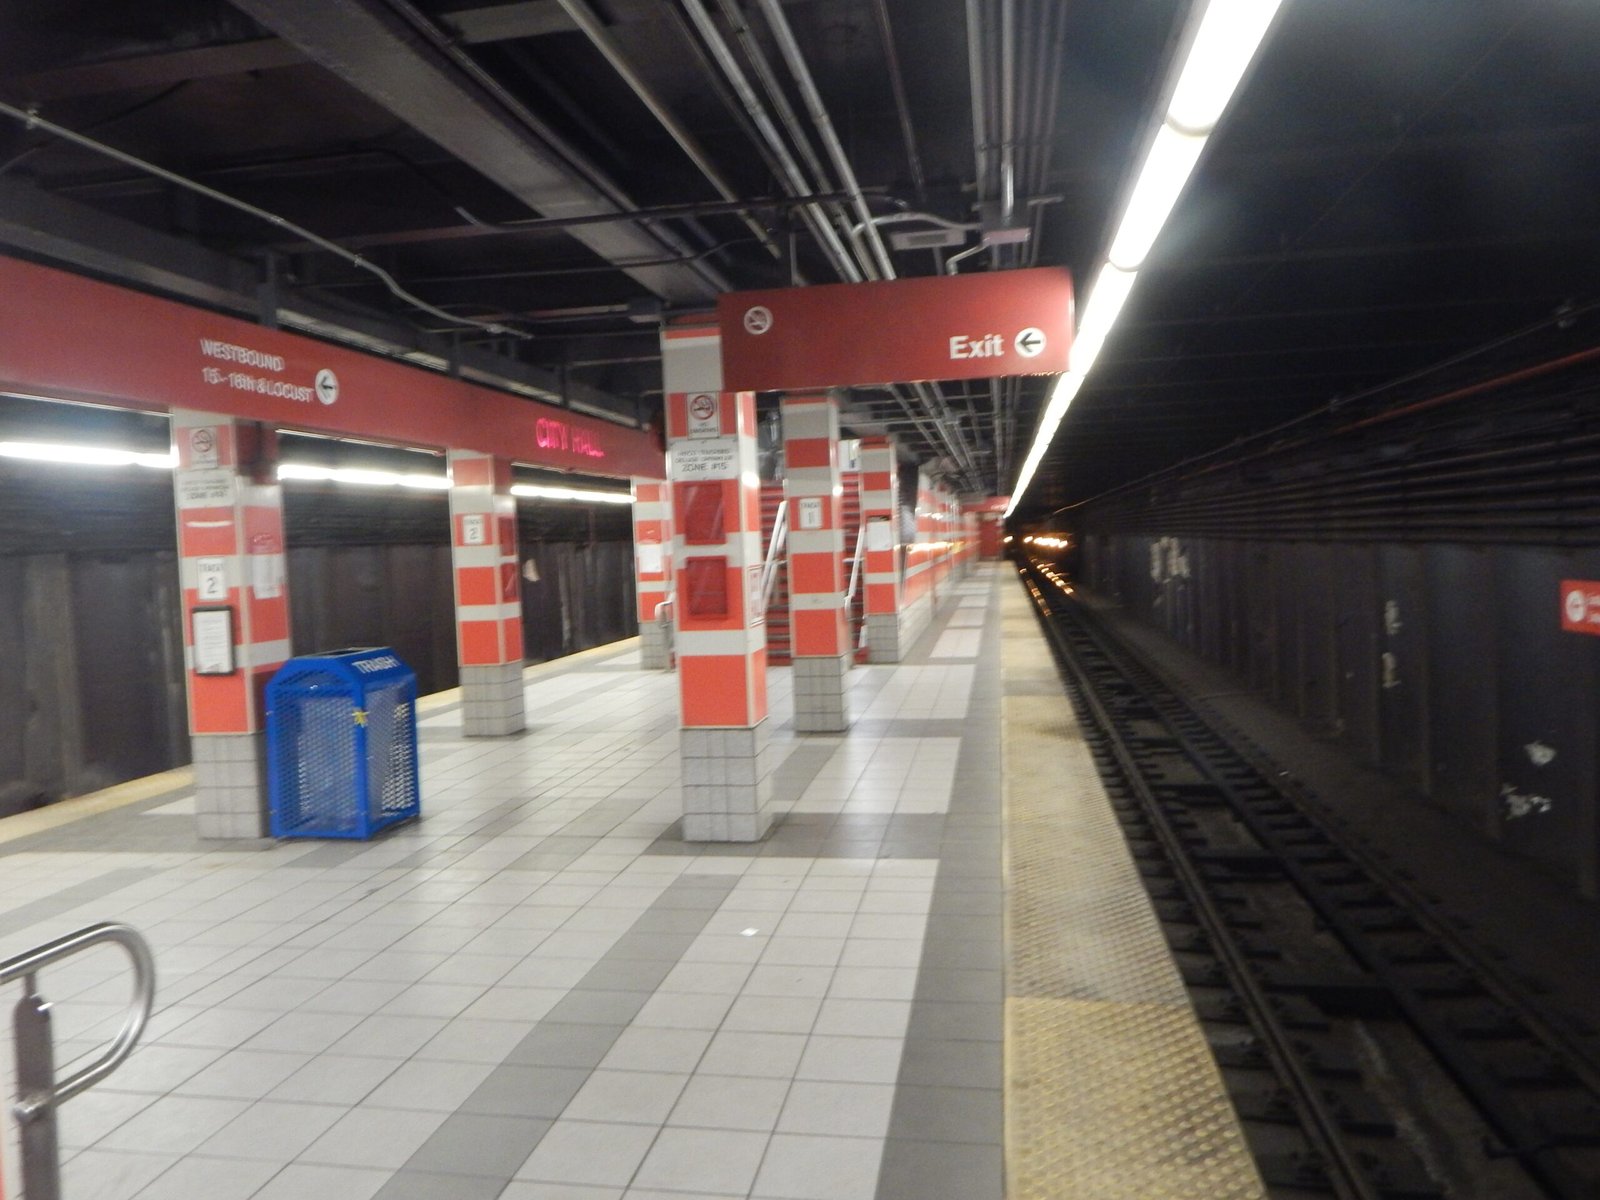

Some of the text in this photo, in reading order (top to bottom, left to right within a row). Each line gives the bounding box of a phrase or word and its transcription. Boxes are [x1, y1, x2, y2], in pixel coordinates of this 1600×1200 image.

[200, 338, 284, 371] WESTBOUND
[949, 334, 1004, 359] Exit
[266, 380, 314, 403] LOCUST
[536, 417, 569, 450] CITY
[681, 462, 708, 472] ZONE
[469, 527, 480, 540] 2
[205, 576, 219, 594] 2
[351, 655, 401, 674] TRASH
